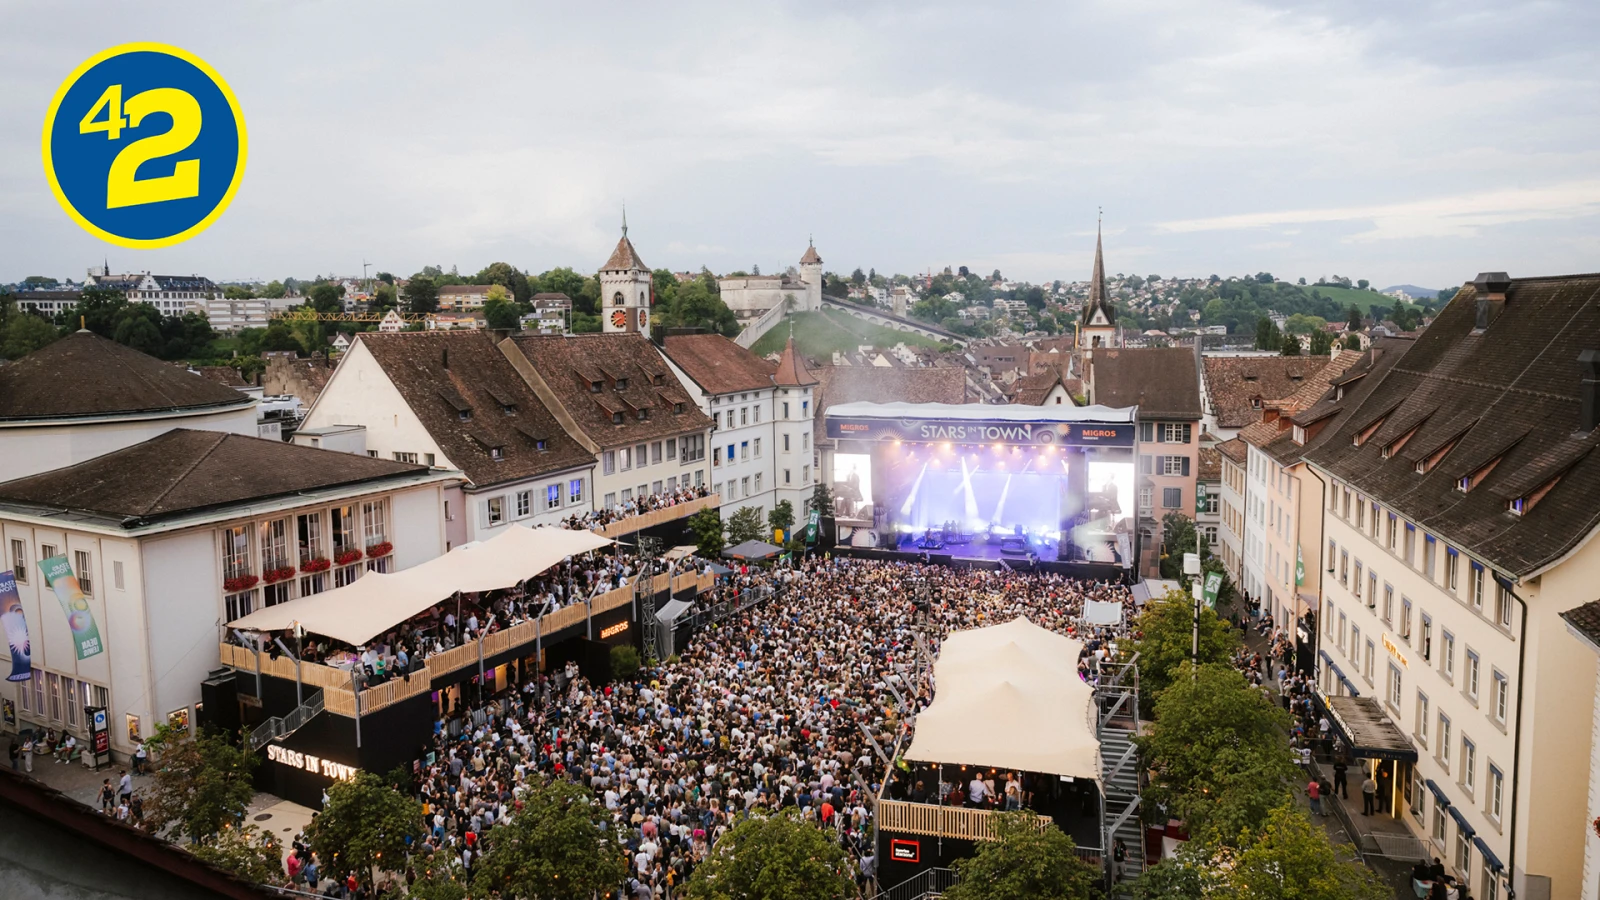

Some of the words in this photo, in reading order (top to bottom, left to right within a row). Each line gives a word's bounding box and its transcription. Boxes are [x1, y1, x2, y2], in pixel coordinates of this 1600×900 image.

[920, 425, 967, 439] STARS
[978, 426, 1032, 440] TOWN
[1082, 429, 1116, 437] MIGROS
[601, 620, 629, 639] MIGROS
[267, 744, 304, 769] STARS
[305, 754, 320, 774] IN
